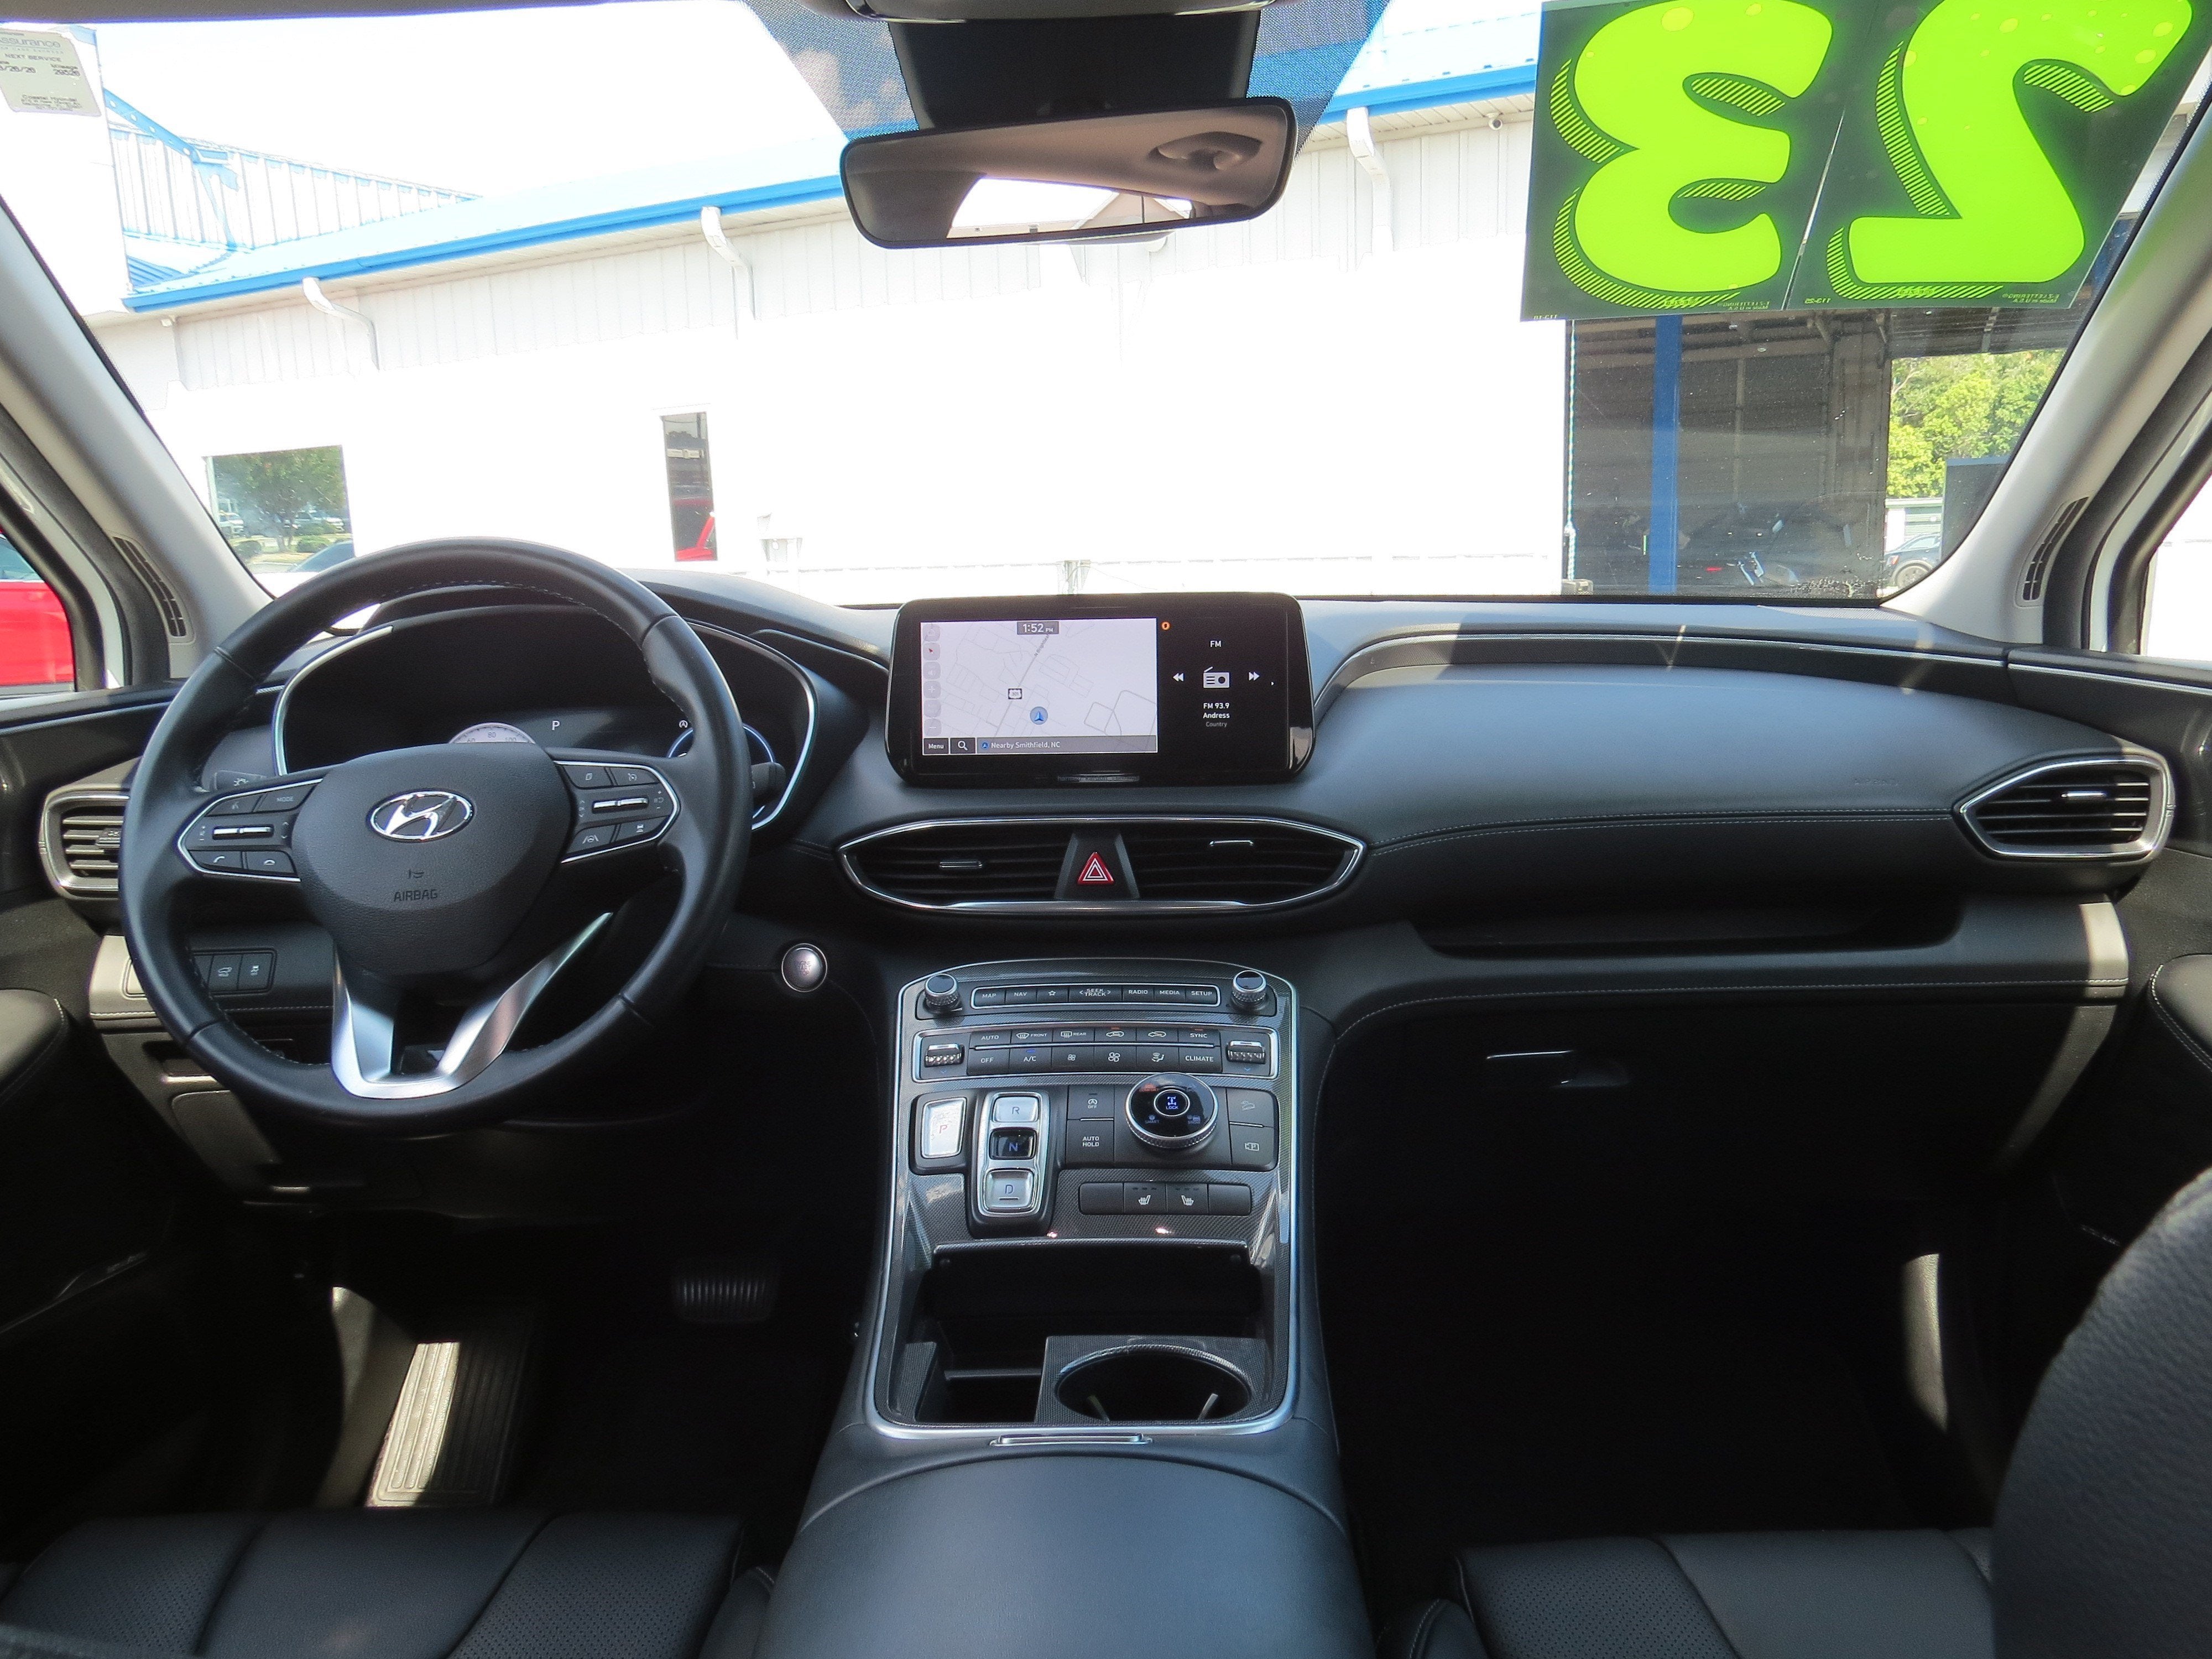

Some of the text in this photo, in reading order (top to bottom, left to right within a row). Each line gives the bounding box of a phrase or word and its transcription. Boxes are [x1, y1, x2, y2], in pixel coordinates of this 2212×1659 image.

[1022, 623, 1044, 633] 1:52
[551, 721, 560, 731] P
[394, 889, 438, 902] AIRBAG
[1011, 1107, 1020, 1115] R
[940, 1124, 948, 1134] P
[1008, 1142, 1019, 1151] N
[1004, 1183, 1014, 1194] D
